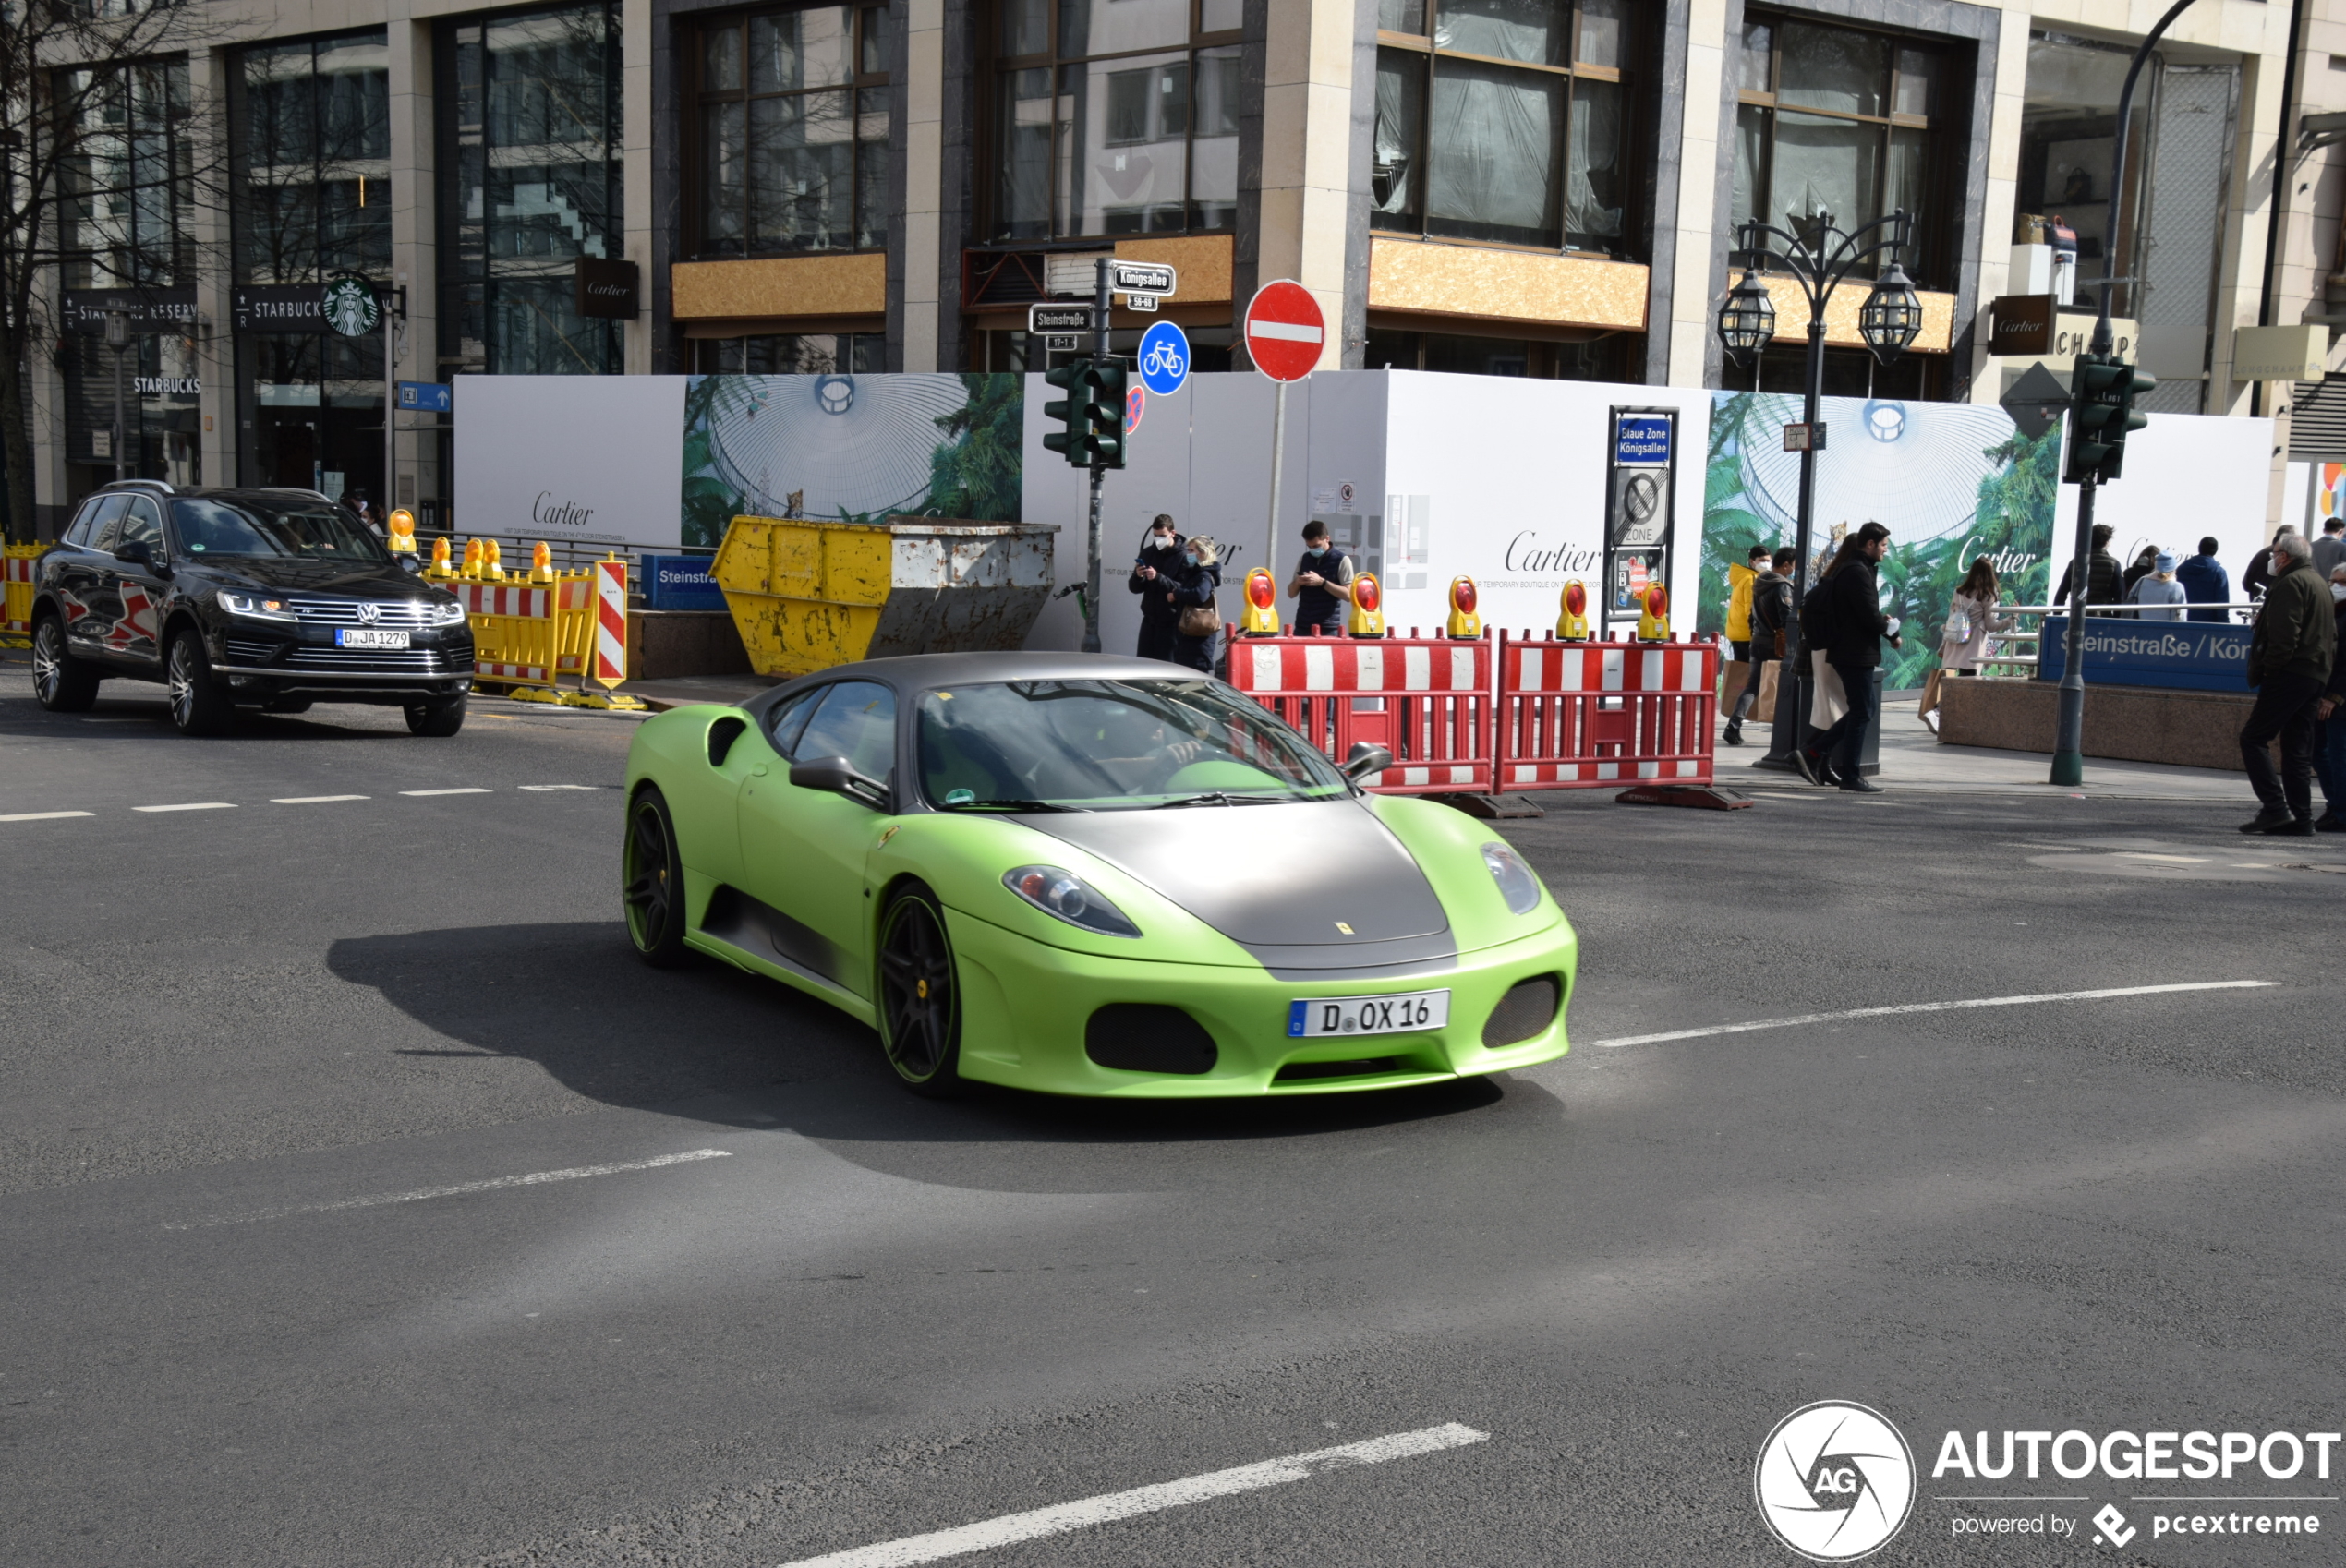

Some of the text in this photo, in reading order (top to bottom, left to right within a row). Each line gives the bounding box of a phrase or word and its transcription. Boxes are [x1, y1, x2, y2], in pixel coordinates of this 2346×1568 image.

[1120, 271, 1167, 287] Königsallee
[587, 282, 630, 296] Cartier
[1134, 296, 1153, 308] 56-68
[255, 302, 320, 318] STARBUCK
[1037, 312, 1085, 326] Steinstraße
[1999, 319, 2043, 333] Cartier
[1054, 338, 1069, 347] 17-1
[134, 377, 201, 394] STARBUCKS
[1622, 428, 1666, 440] Blaue Zone
[1620, 441, 1667, 456] Königsallee
[533, 490, 594, 525] Cartier
[1626, 528, 1652, 541] ZONE
[1505, 529, 1602, 572] Cartier
[345, 632, 352, 643] D
[1322, 997, 1430, 1031] D OX 16
